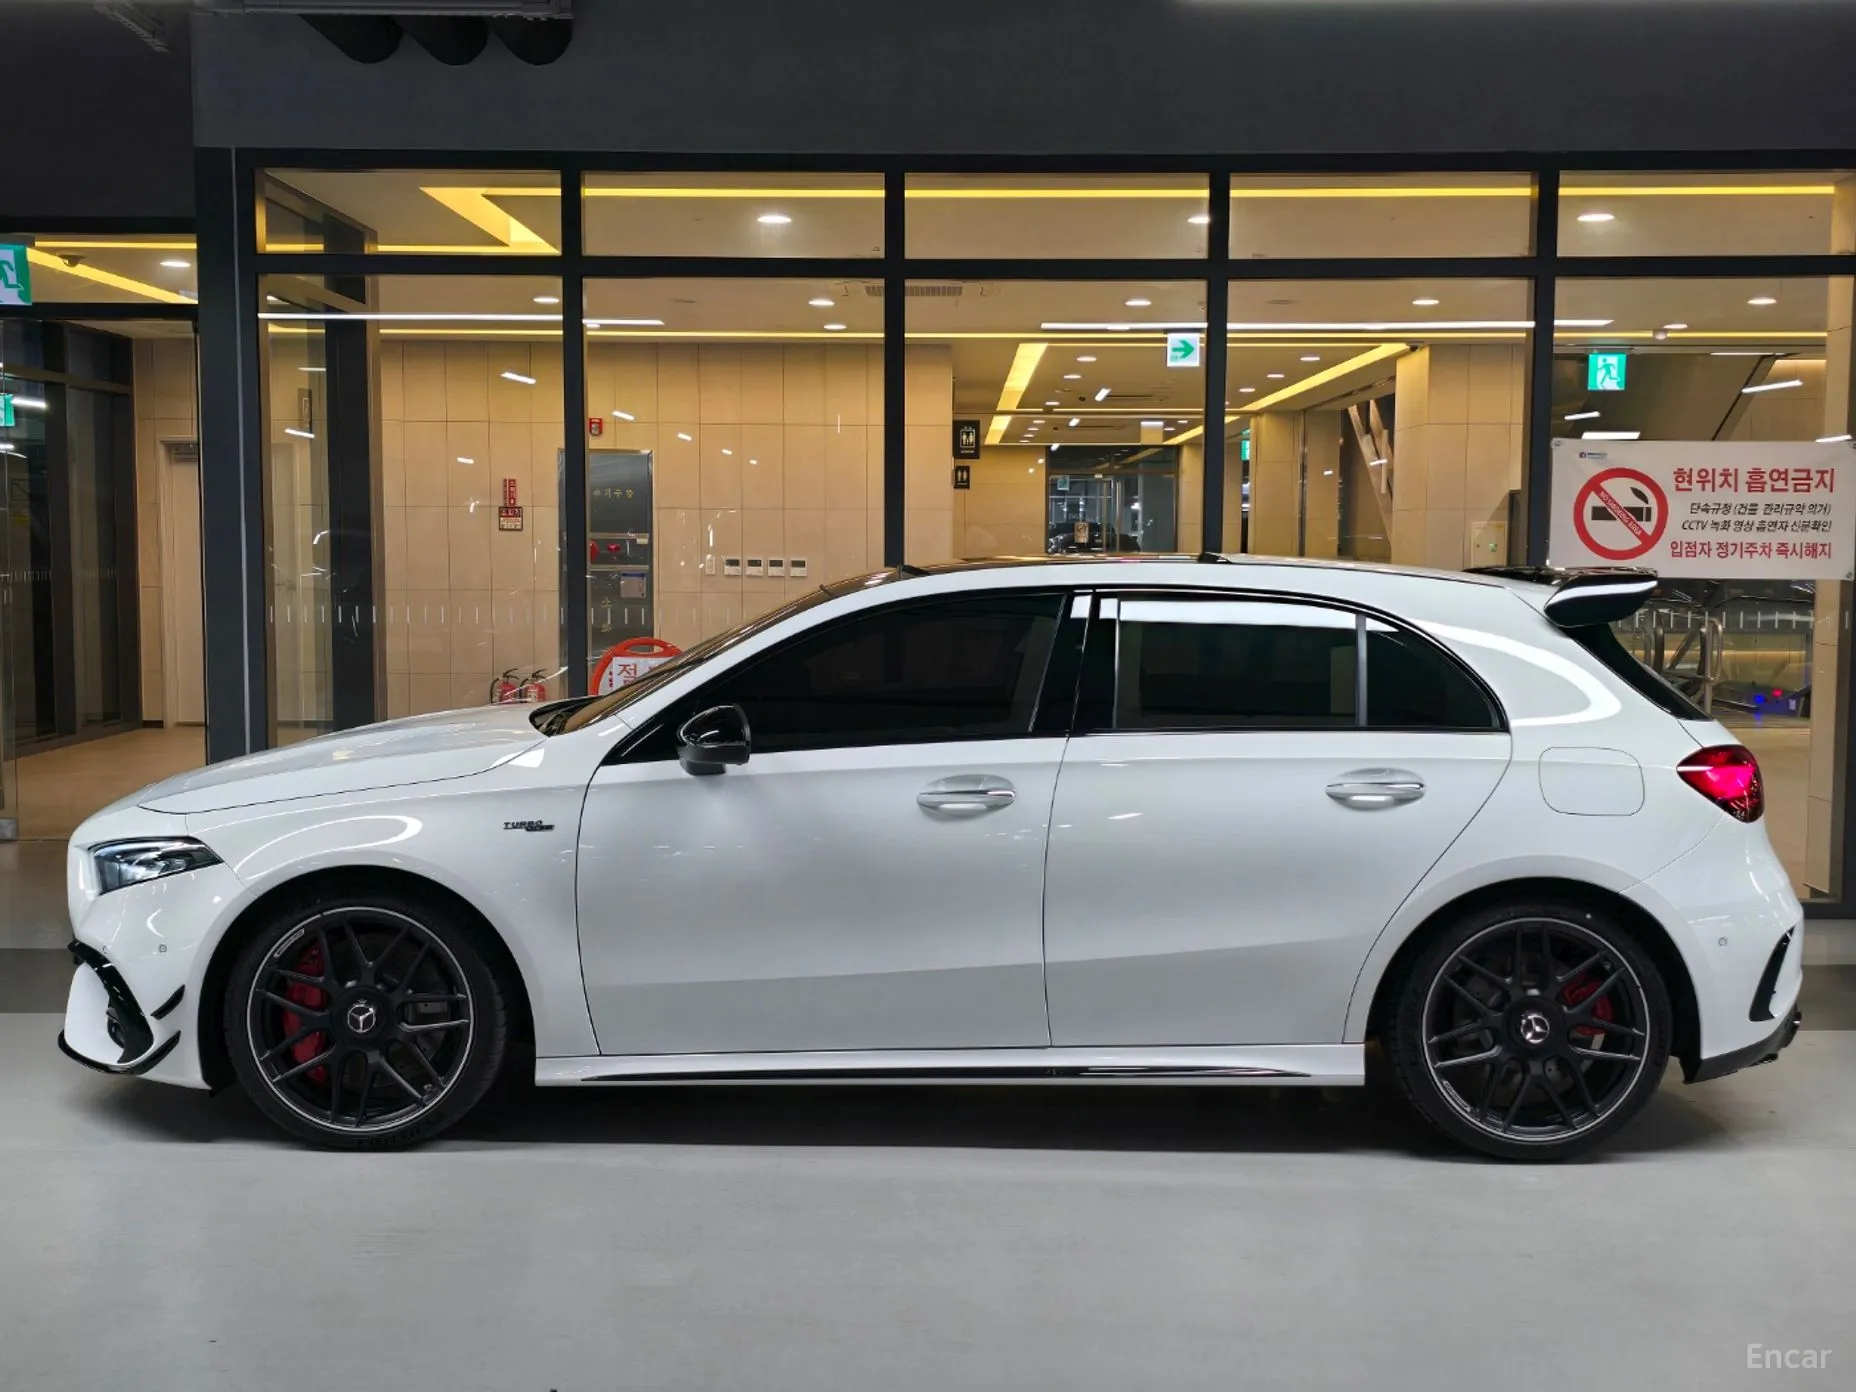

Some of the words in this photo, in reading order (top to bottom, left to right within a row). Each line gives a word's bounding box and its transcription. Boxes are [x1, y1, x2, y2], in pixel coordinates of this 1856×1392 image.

[1673, 467, 1739, 493] 현위치
[1745, 467, 1835, 493] 흡연금지
[1690, 502, 1733, 515] 단속규정
[1763, 502, 1806, 516] 관리규약
[1681, 519, 1708, 531] CCTV
[1710, 519, 1732, 532] 녹화
[1733, 519, 1754, 533] 영상
[1756, 519, 1789, 533] 흡연자
[1670, 541, 1713, 559] 입점자
[1716, 541, 1772, 559] 정기주차
[1776, 541, 1832, 560] 즉시해지
